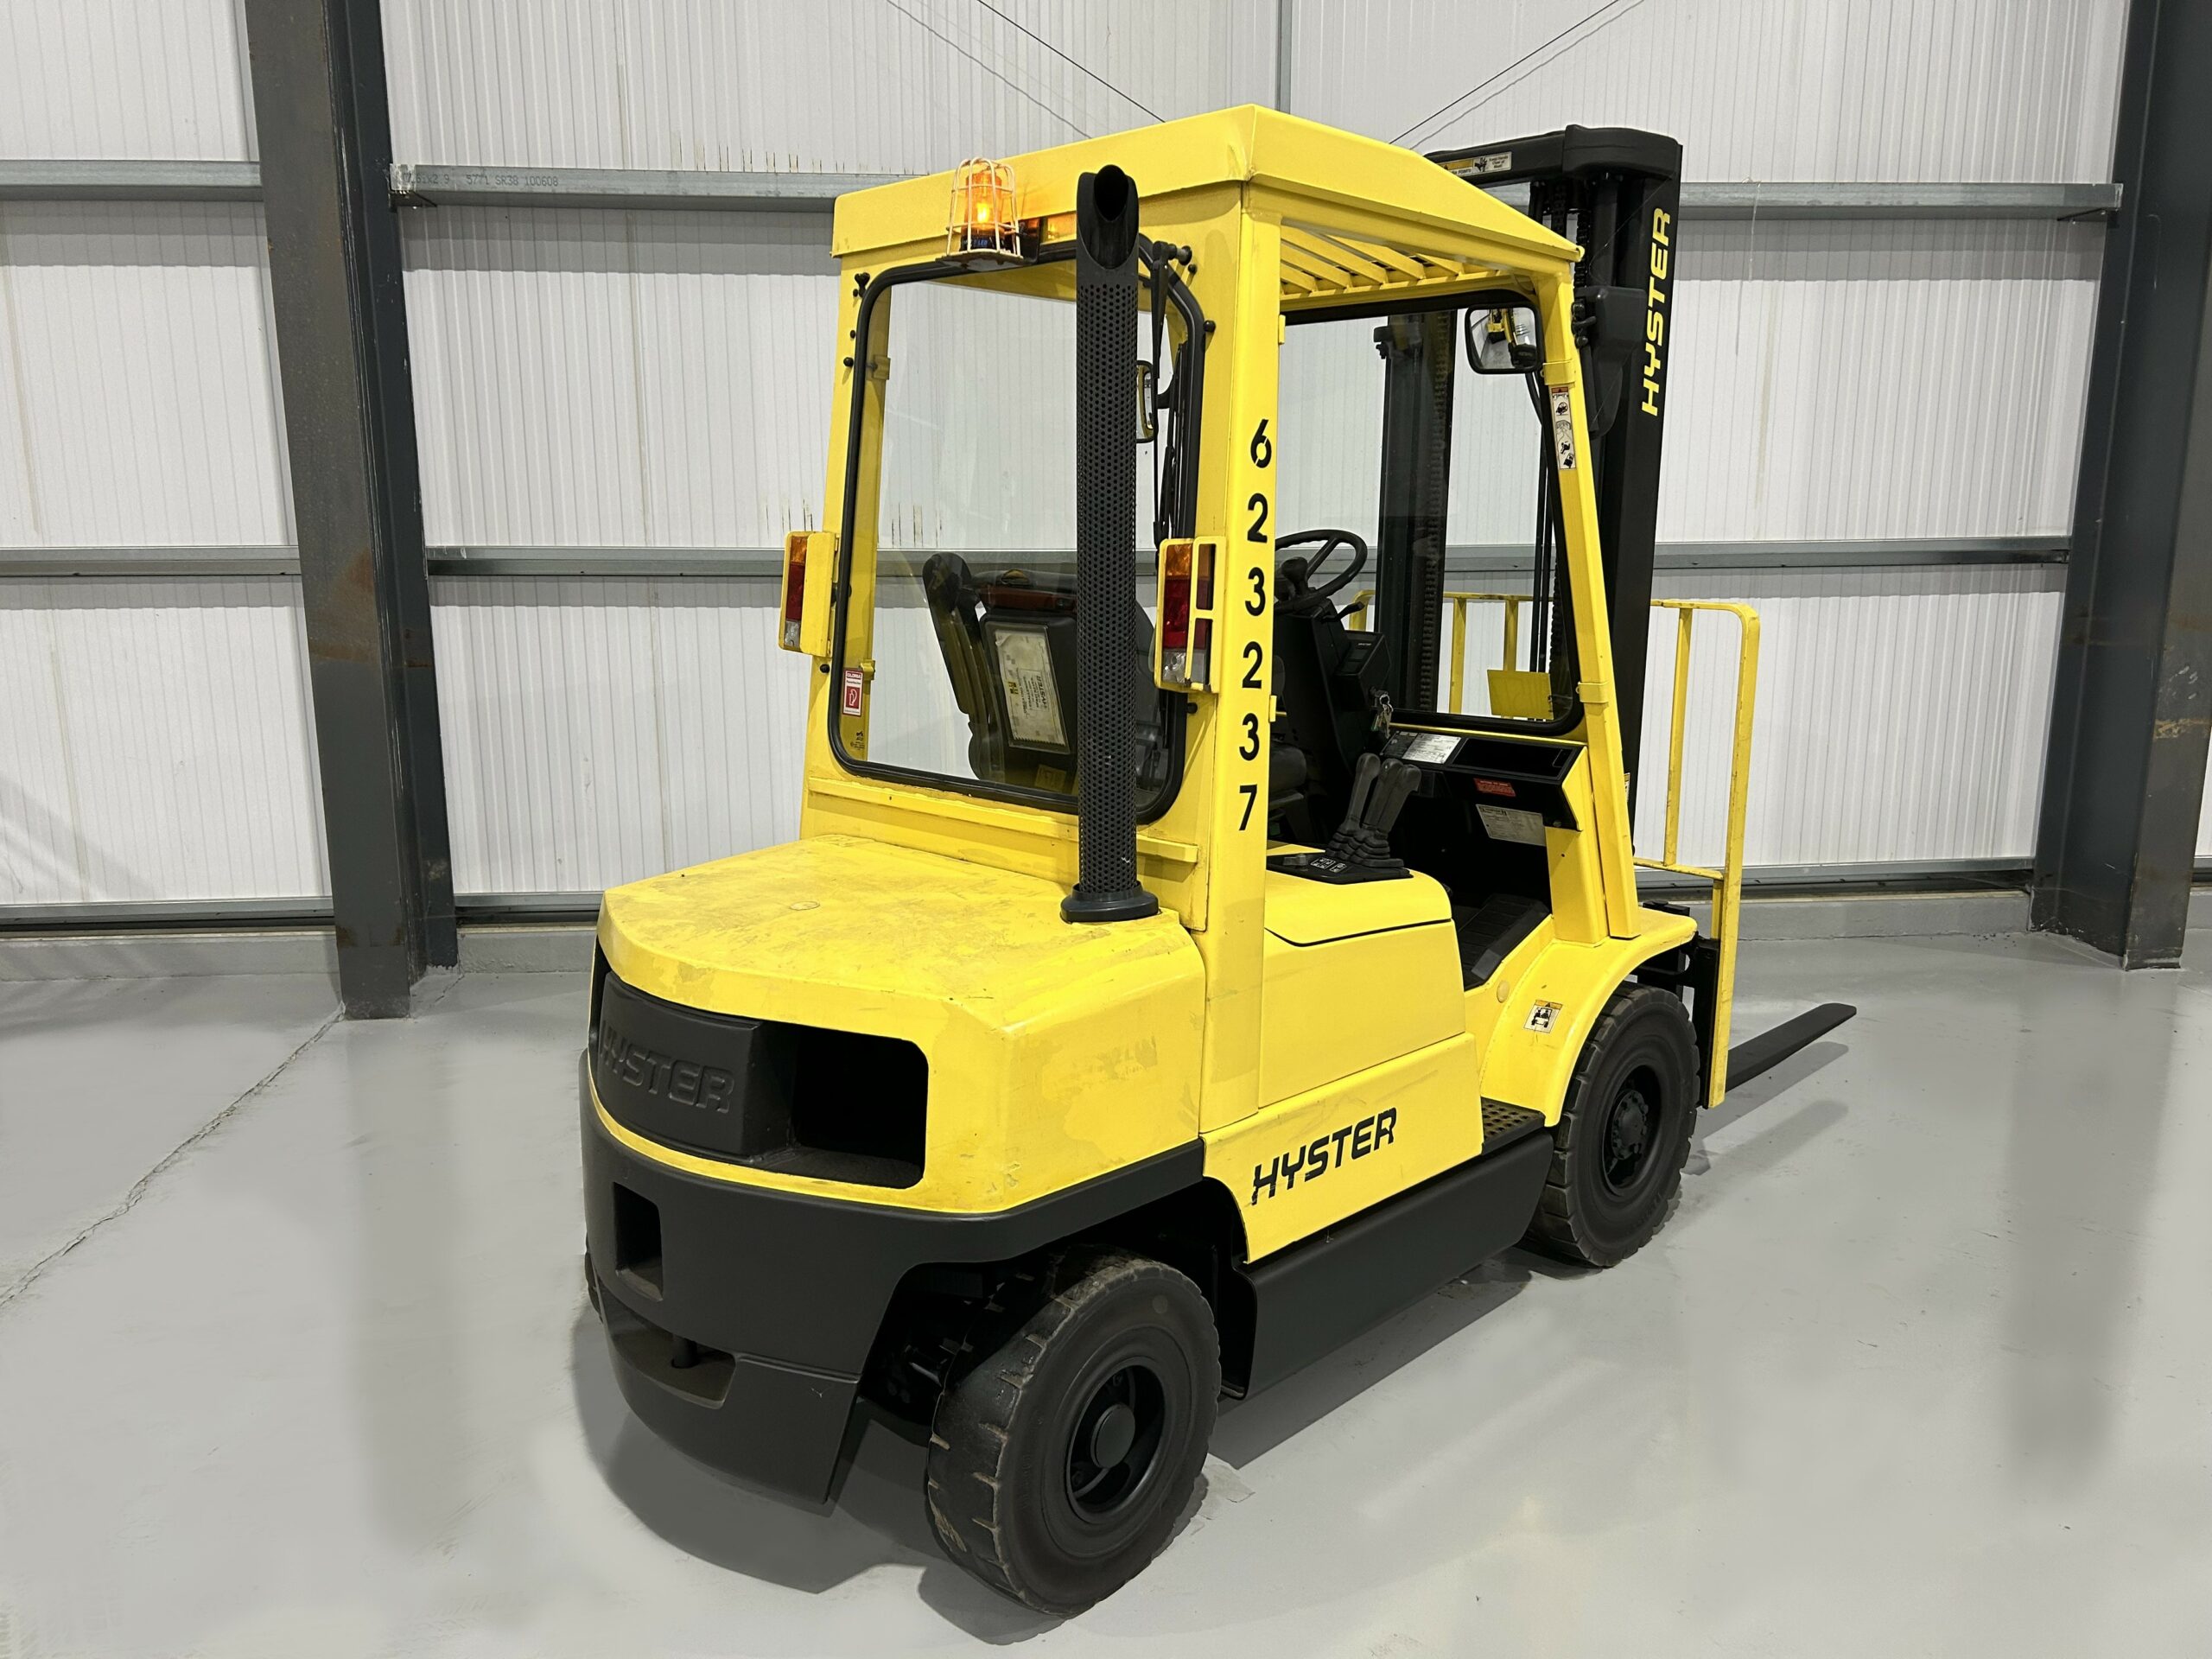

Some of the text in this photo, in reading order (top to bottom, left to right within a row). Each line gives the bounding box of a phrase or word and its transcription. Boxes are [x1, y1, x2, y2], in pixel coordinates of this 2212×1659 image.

[495, 175, 518, 186] SR38
[524, 175, 559, 187] 100608
[1642, 207, 1671, 416] HYSTER
[600, 1020, 734, 1114] HYSTER
[1251, 1107, 1397, 1206] HYSTER
